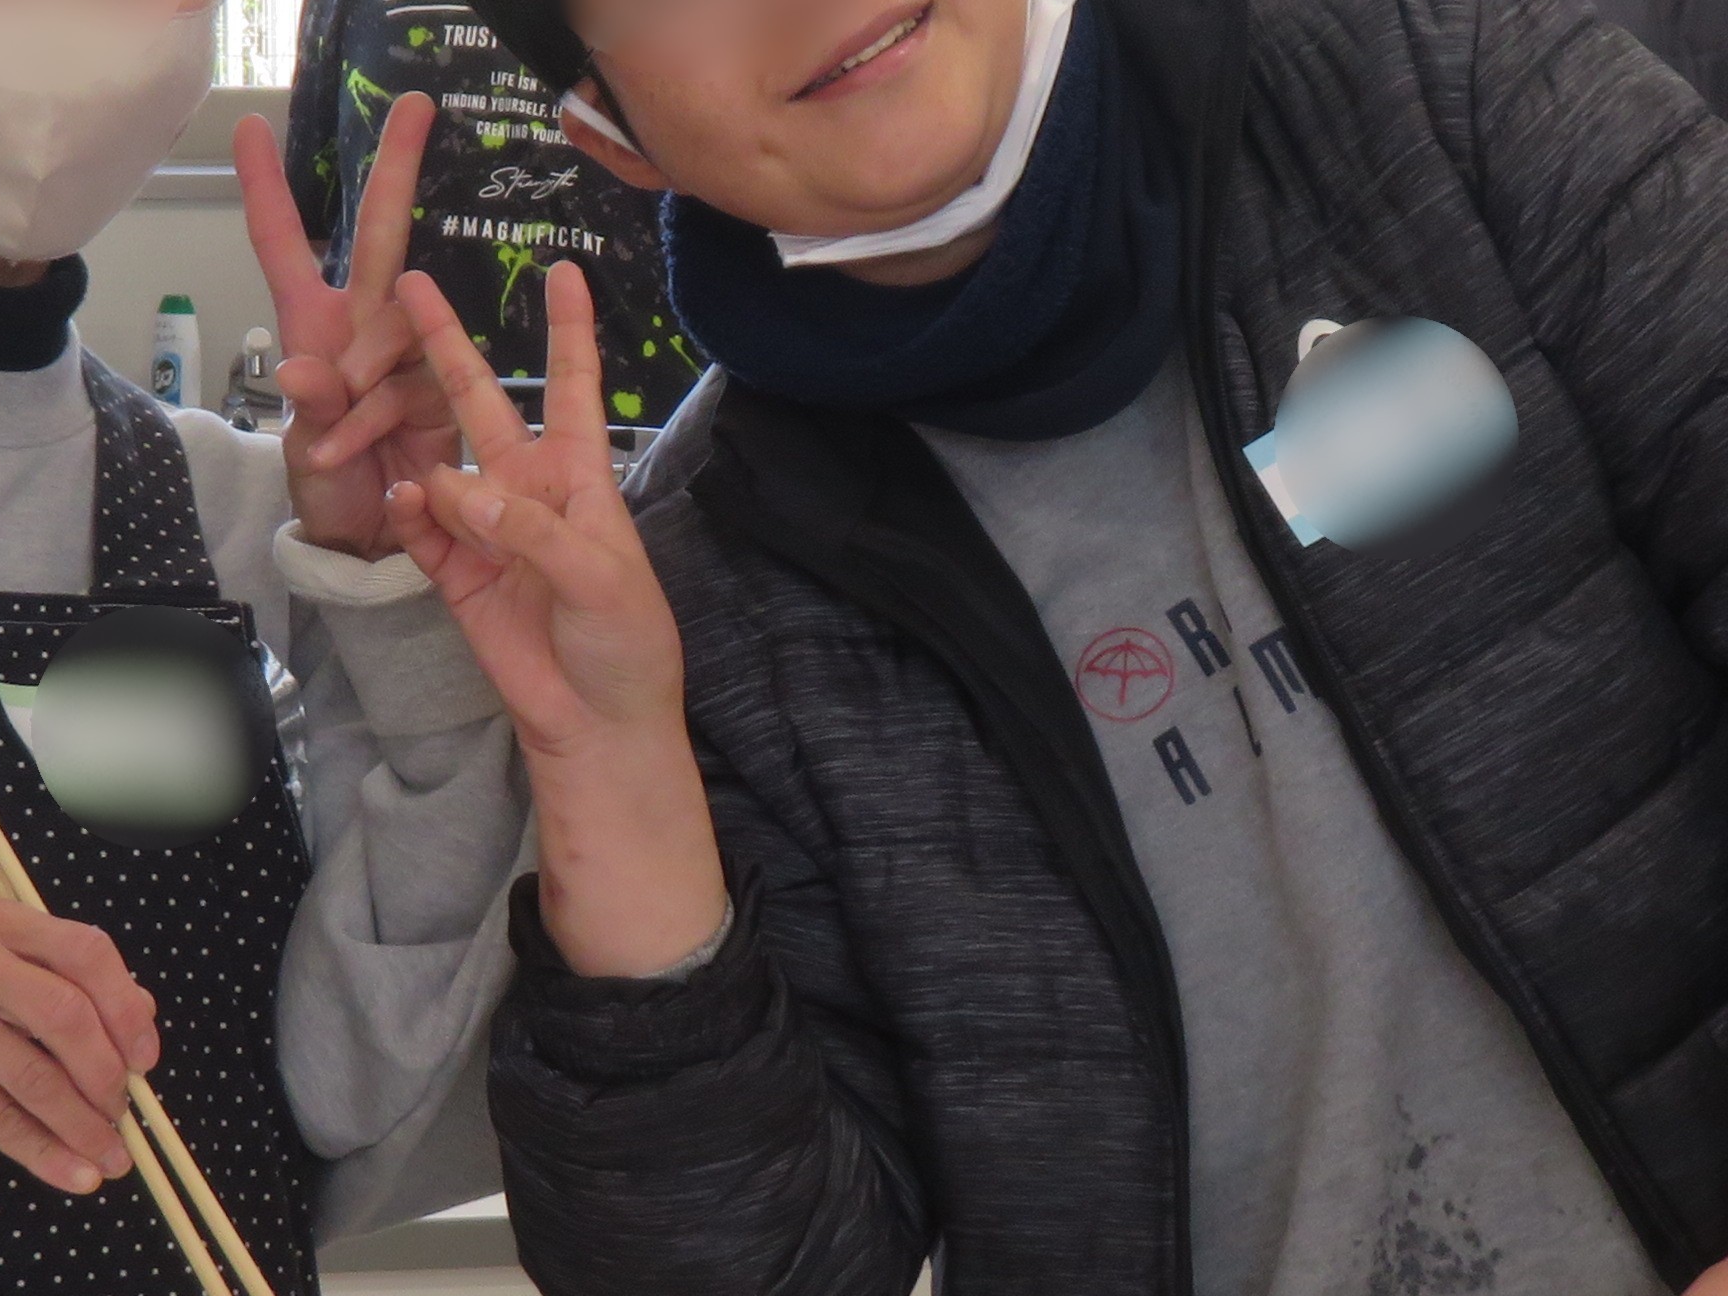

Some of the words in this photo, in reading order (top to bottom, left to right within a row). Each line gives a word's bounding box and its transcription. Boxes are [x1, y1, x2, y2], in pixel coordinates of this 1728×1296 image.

[490, 71, 514, 87] LIFE
[442, 93, 487, 111] FINDING
[491, 97, 548, 118] YOURSELF.
[476, 120, 528, 139] CREATING
[532, 126, 573, 146] YOURS
[442, 214, 605, 256] #MAGNIFICENT
